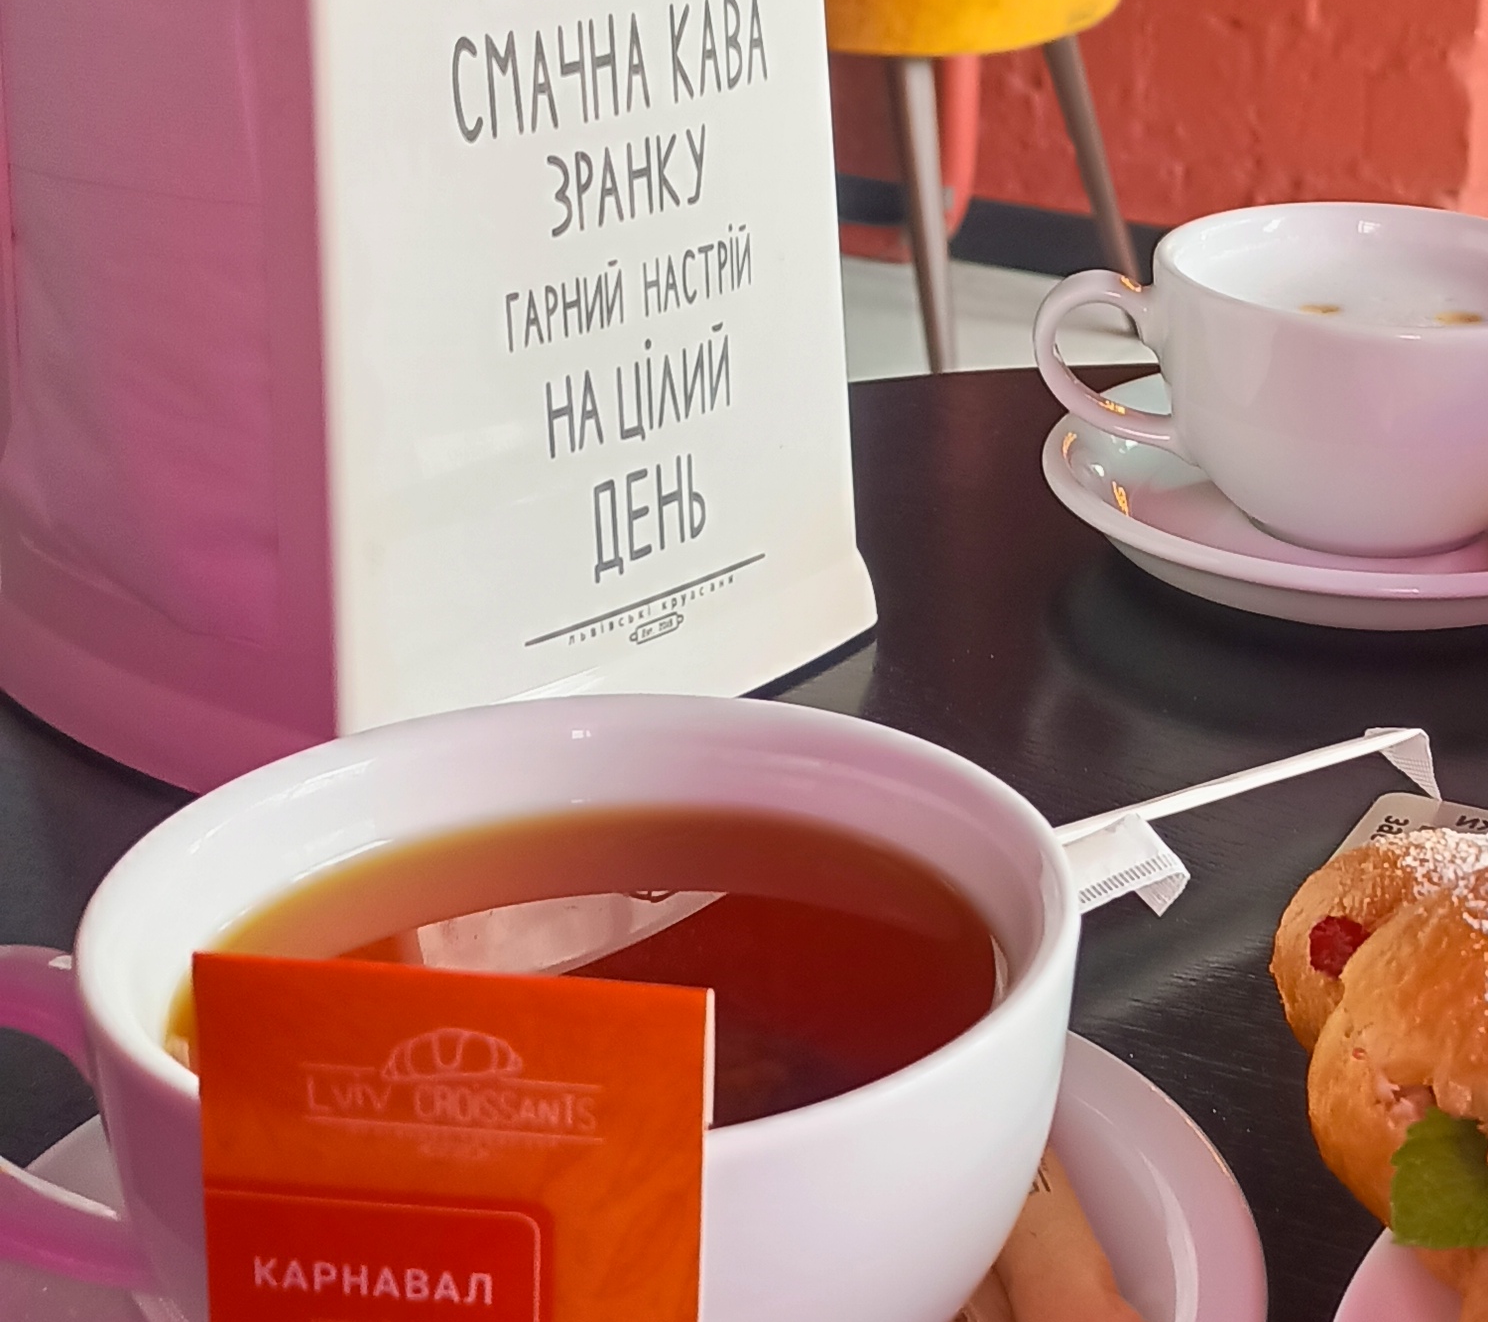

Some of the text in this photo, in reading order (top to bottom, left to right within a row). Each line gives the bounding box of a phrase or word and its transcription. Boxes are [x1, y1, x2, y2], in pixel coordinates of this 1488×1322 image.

[451, 10, 651, 143] СМАЧНА
[546, 124, 708, 237] ЗРАНКУ
[504, 223, 753, 353] ГАРНИЙ НАСТРІЙ
[544, 322, 732, 459] НА ЦІЛИЙ
[592, 453, 706, 584] ДЕНЬ
[253, 1255, 493, 1307] КАРНАВАЛ
